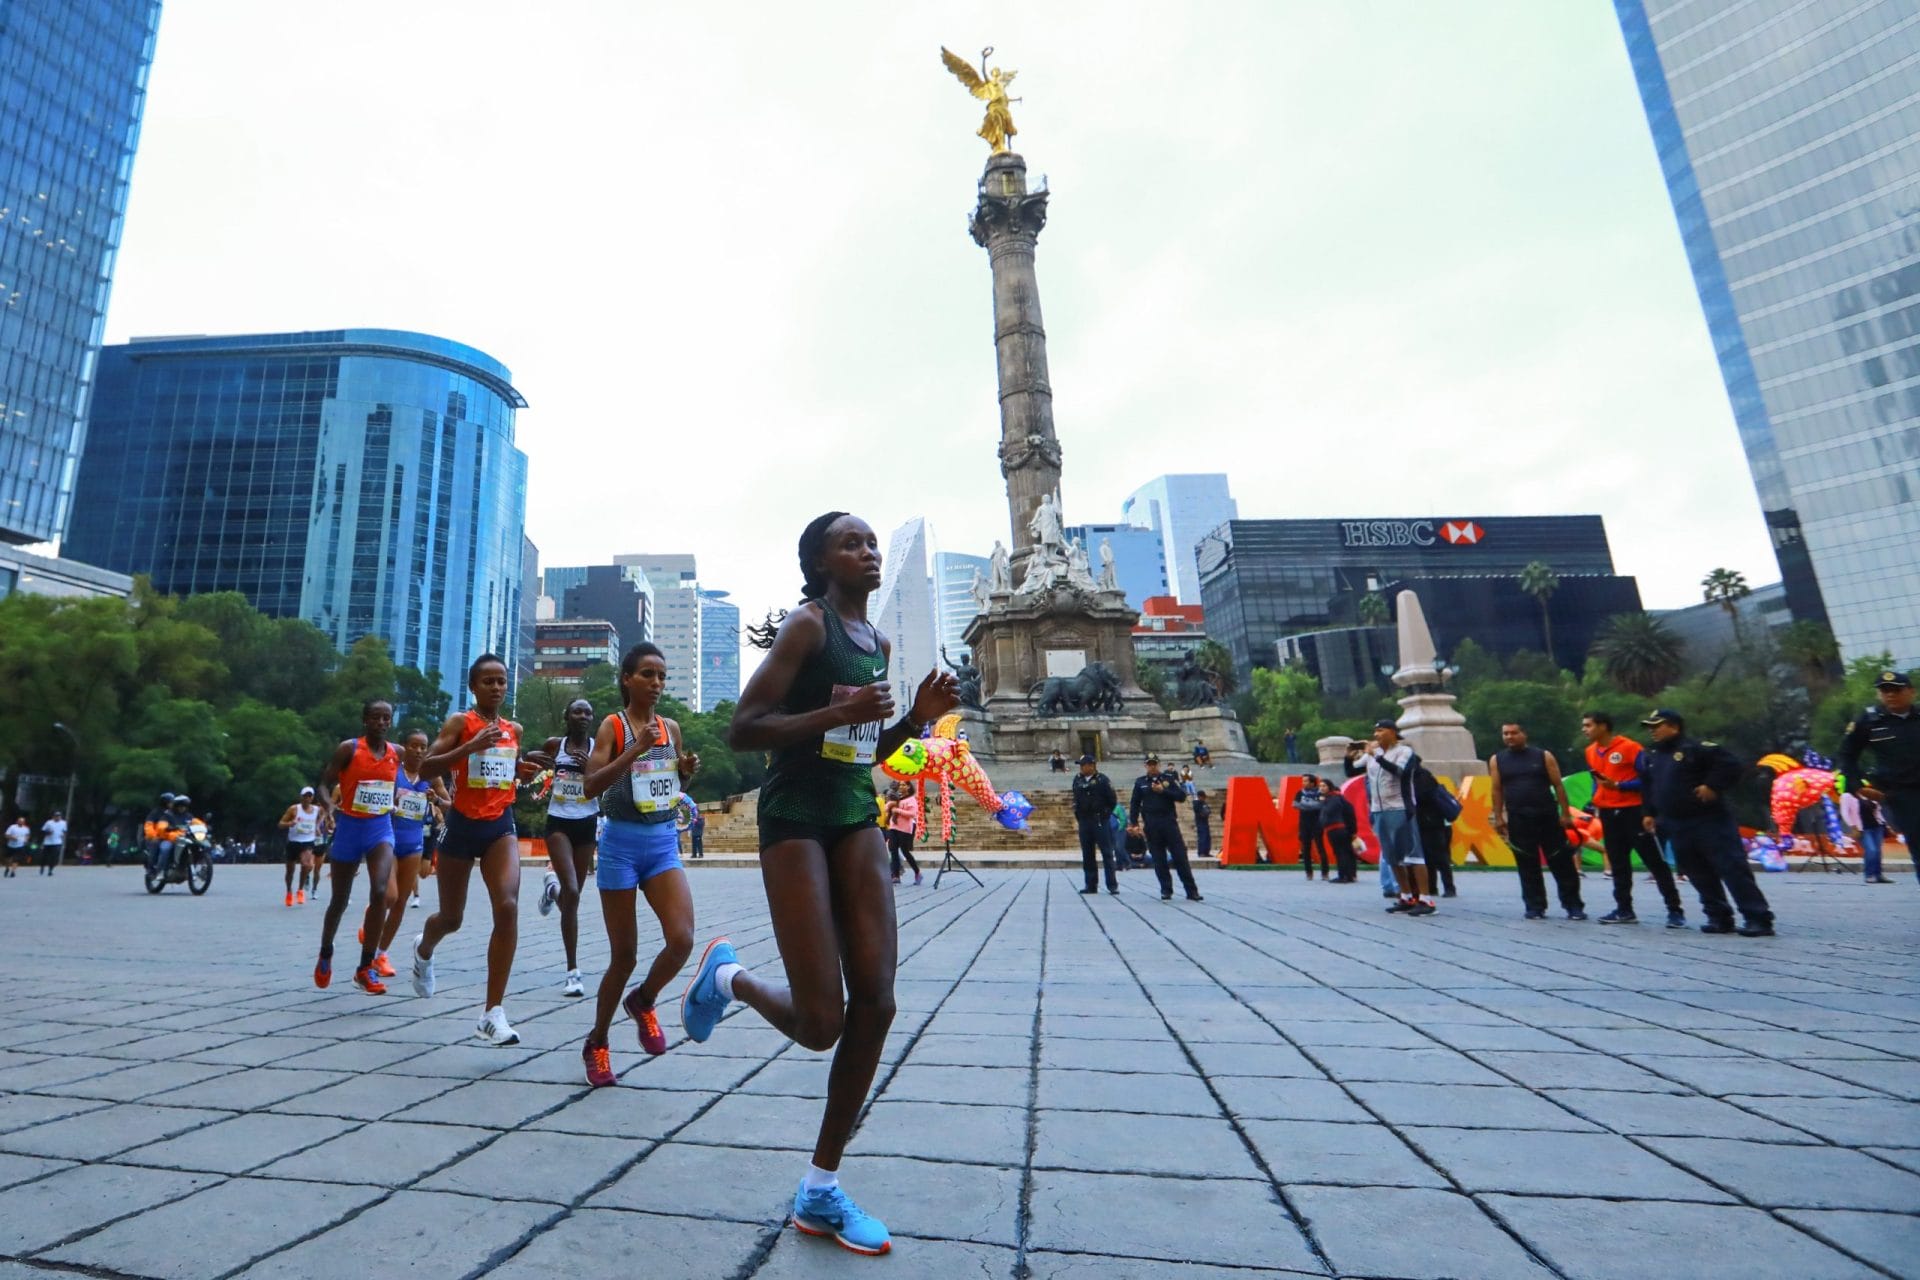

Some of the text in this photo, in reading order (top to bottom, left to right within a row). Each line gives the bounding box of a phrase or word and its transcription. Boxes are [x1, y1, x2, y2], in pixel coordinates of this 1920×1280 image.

[1341, 520, 1436, 546] HSBC
[481, 762, 507, 777] ESHETU
[649, 779, 675, 797] GIDEY
